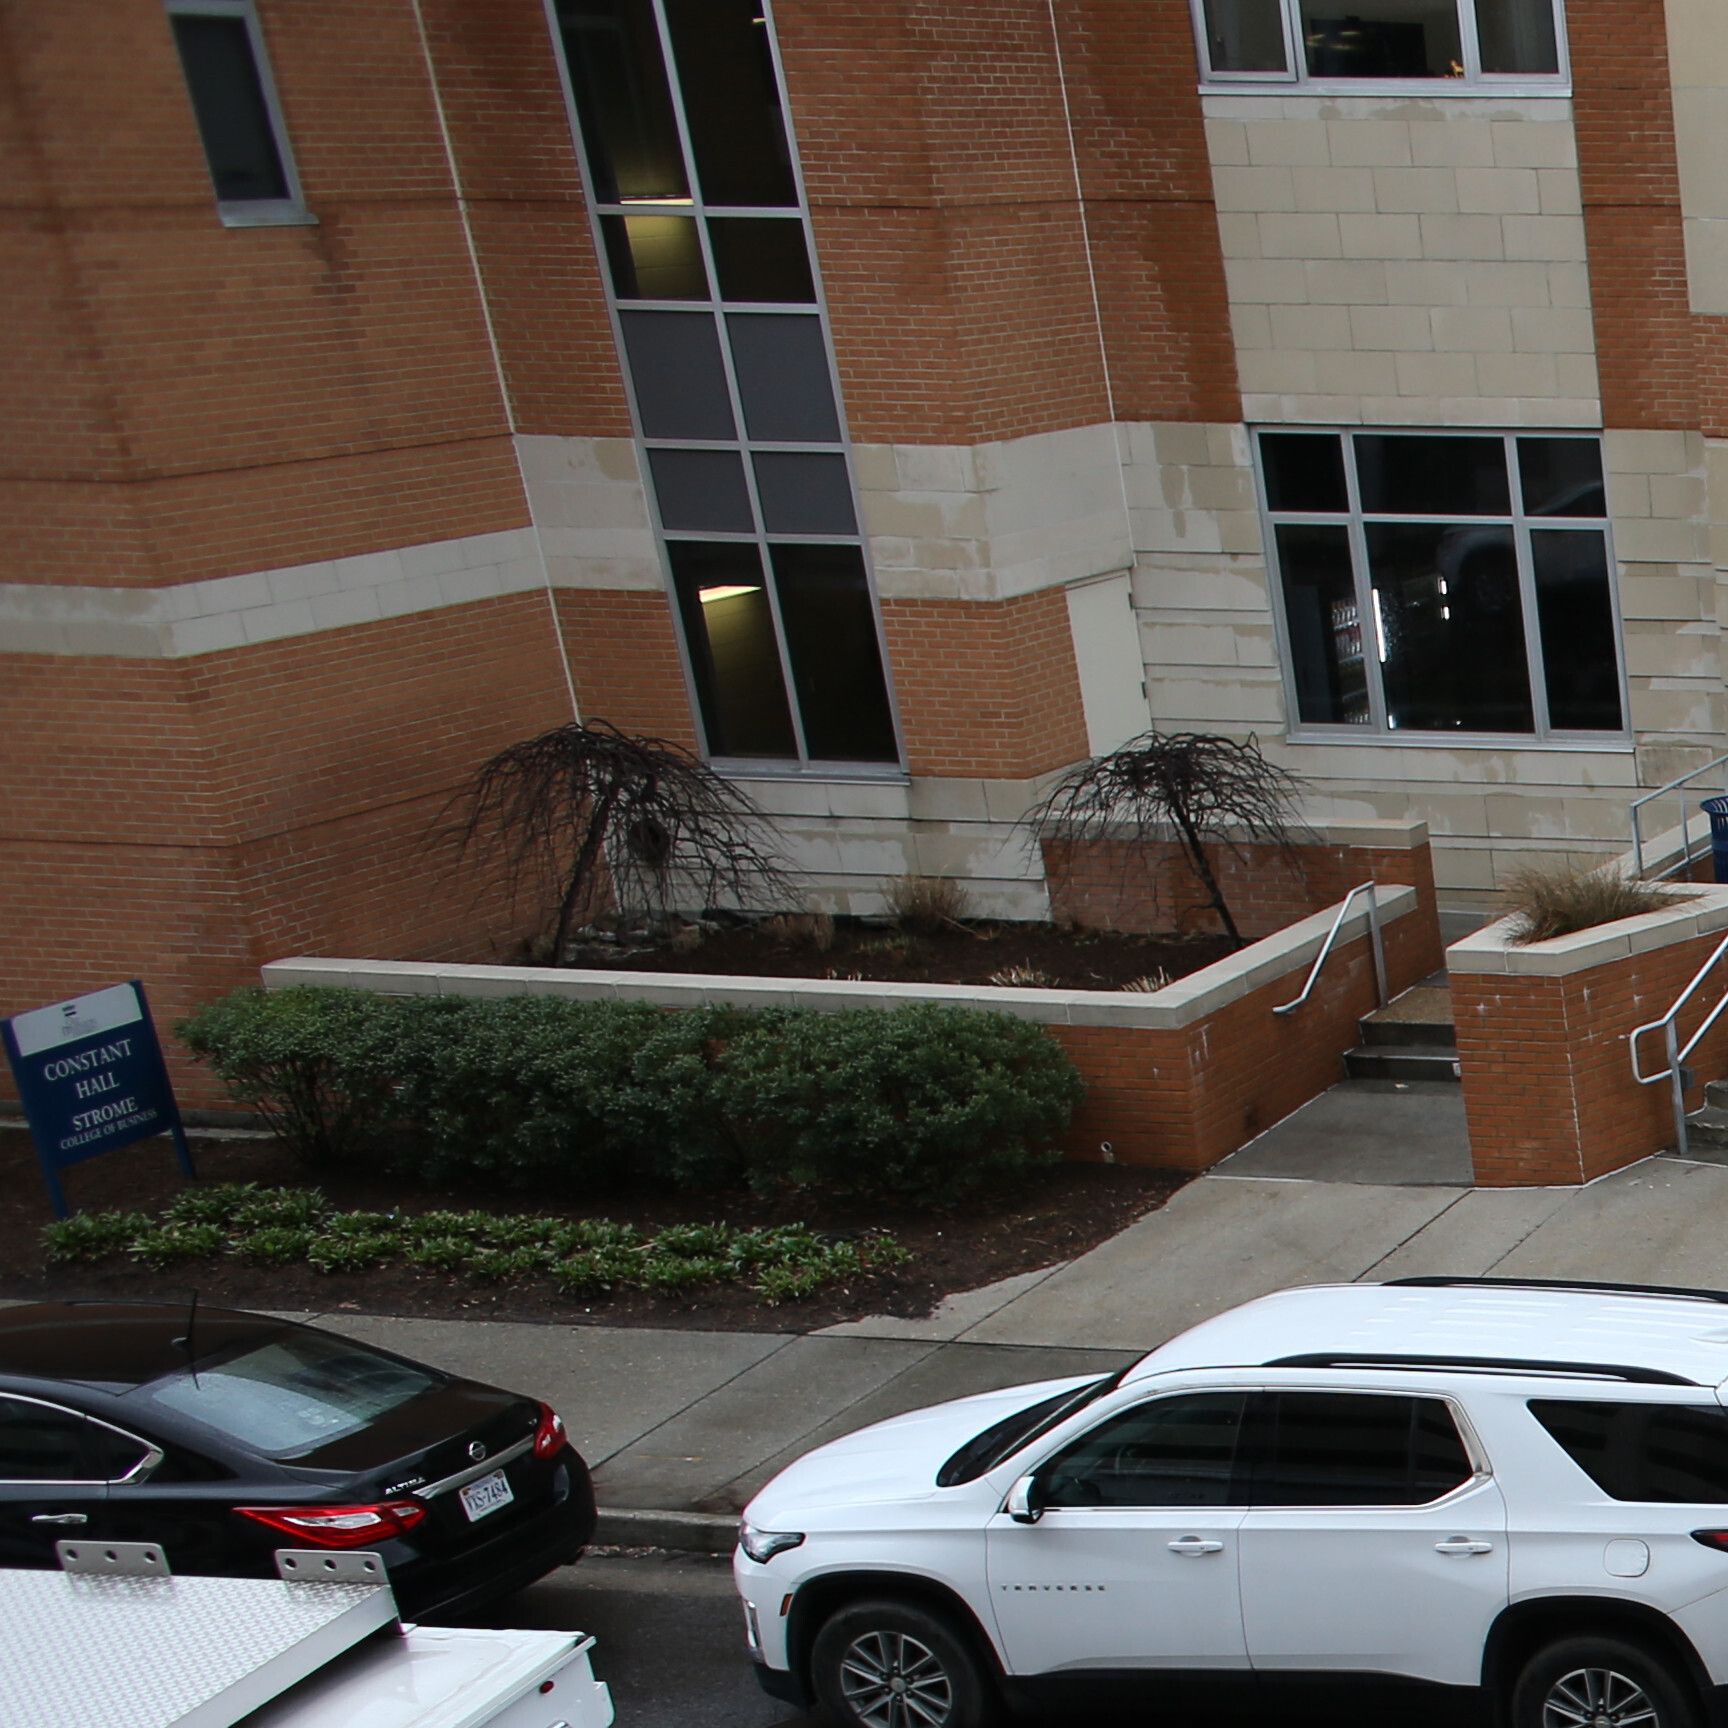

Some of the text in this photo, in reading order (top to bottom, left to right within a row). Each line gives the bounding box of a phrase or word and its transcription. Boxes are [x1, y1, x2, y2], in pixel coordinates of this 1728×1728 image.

[44, 1039, 132, 1081] CONSTANT
[75, 1072, 120, 1099] HALL
[60, 1108, 157, 1150] COLLEGE OF BUSINESS
[72, 1097, 138, 1131] STROME
